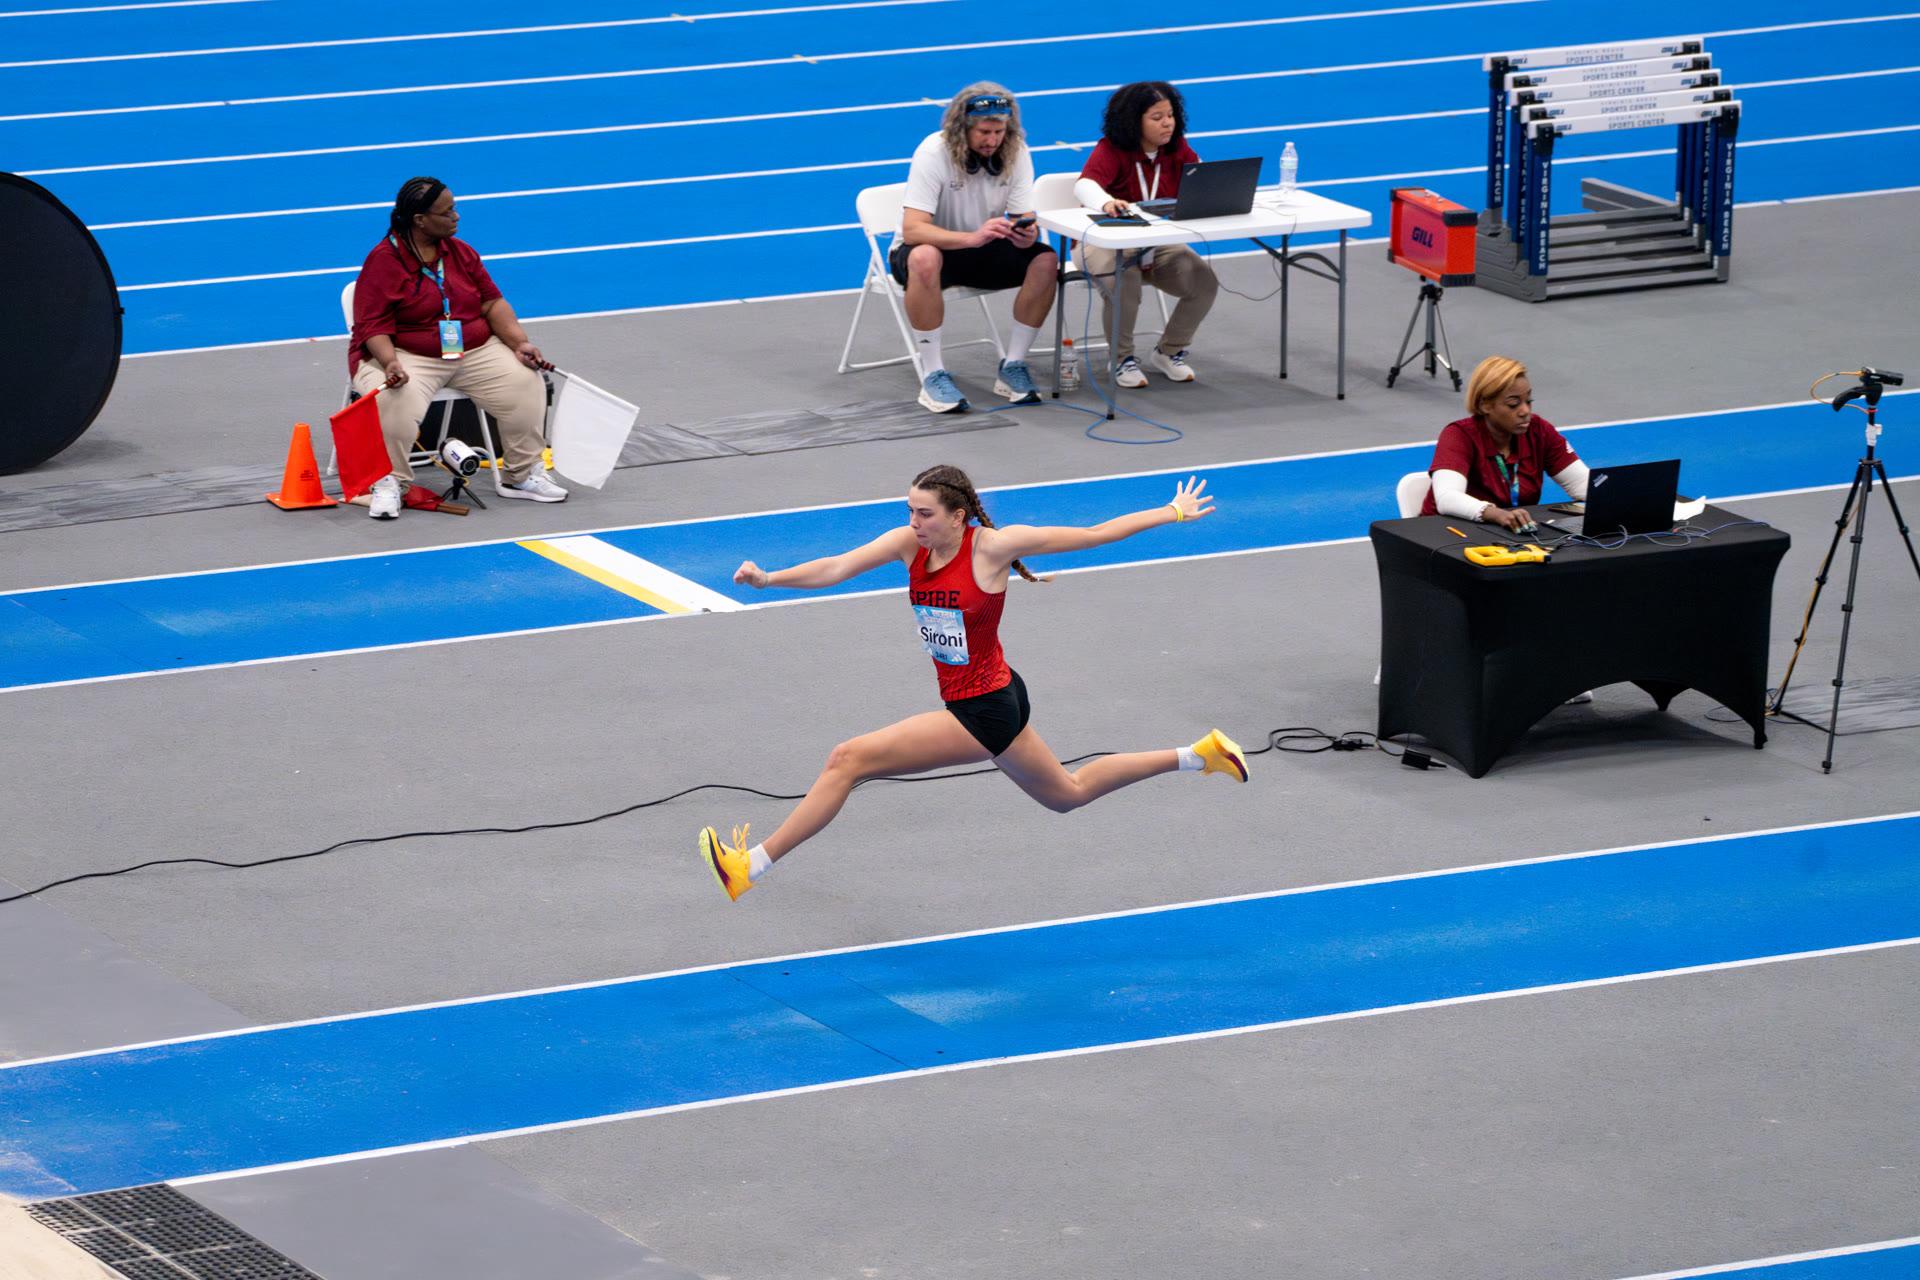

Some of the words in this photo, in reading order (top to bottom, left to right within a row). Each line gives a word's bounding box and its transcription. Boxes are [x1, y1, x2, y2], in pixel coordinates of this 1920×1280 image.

[1565, 56, 1593, 64] SPORTS
[1596, 54, 1624, 62] CENTER
[1582, 72, 1608, 81] SPORTS
[1611, 70, 1637, 79] CENTER
[1589, 88, 1615, 97] SPORTS
[1618, 86, 1645, 95] CENTER
[1601, 105, 1628, 113] SPORTS
[1630, 103, 1657, 111] CENTER
[1495, 94, 1504, 158] VIRGINIA
[1608, 121, 1635, 130] SPORTS
[1637, 119, 1665, 127] CENTER
[1494, 164, 1502, 203] BEACH
[1724, 143, 1733, 205] VIRGINIA
[1541, 162, 1549, 224] VIRGINIA
[1412, 226, 1433, 248] GILL
[1722, 211, 1730, 250] BEACH
[910, 590, 960, 608] SPIRE
[921, 627, 962, 647] Sironi
